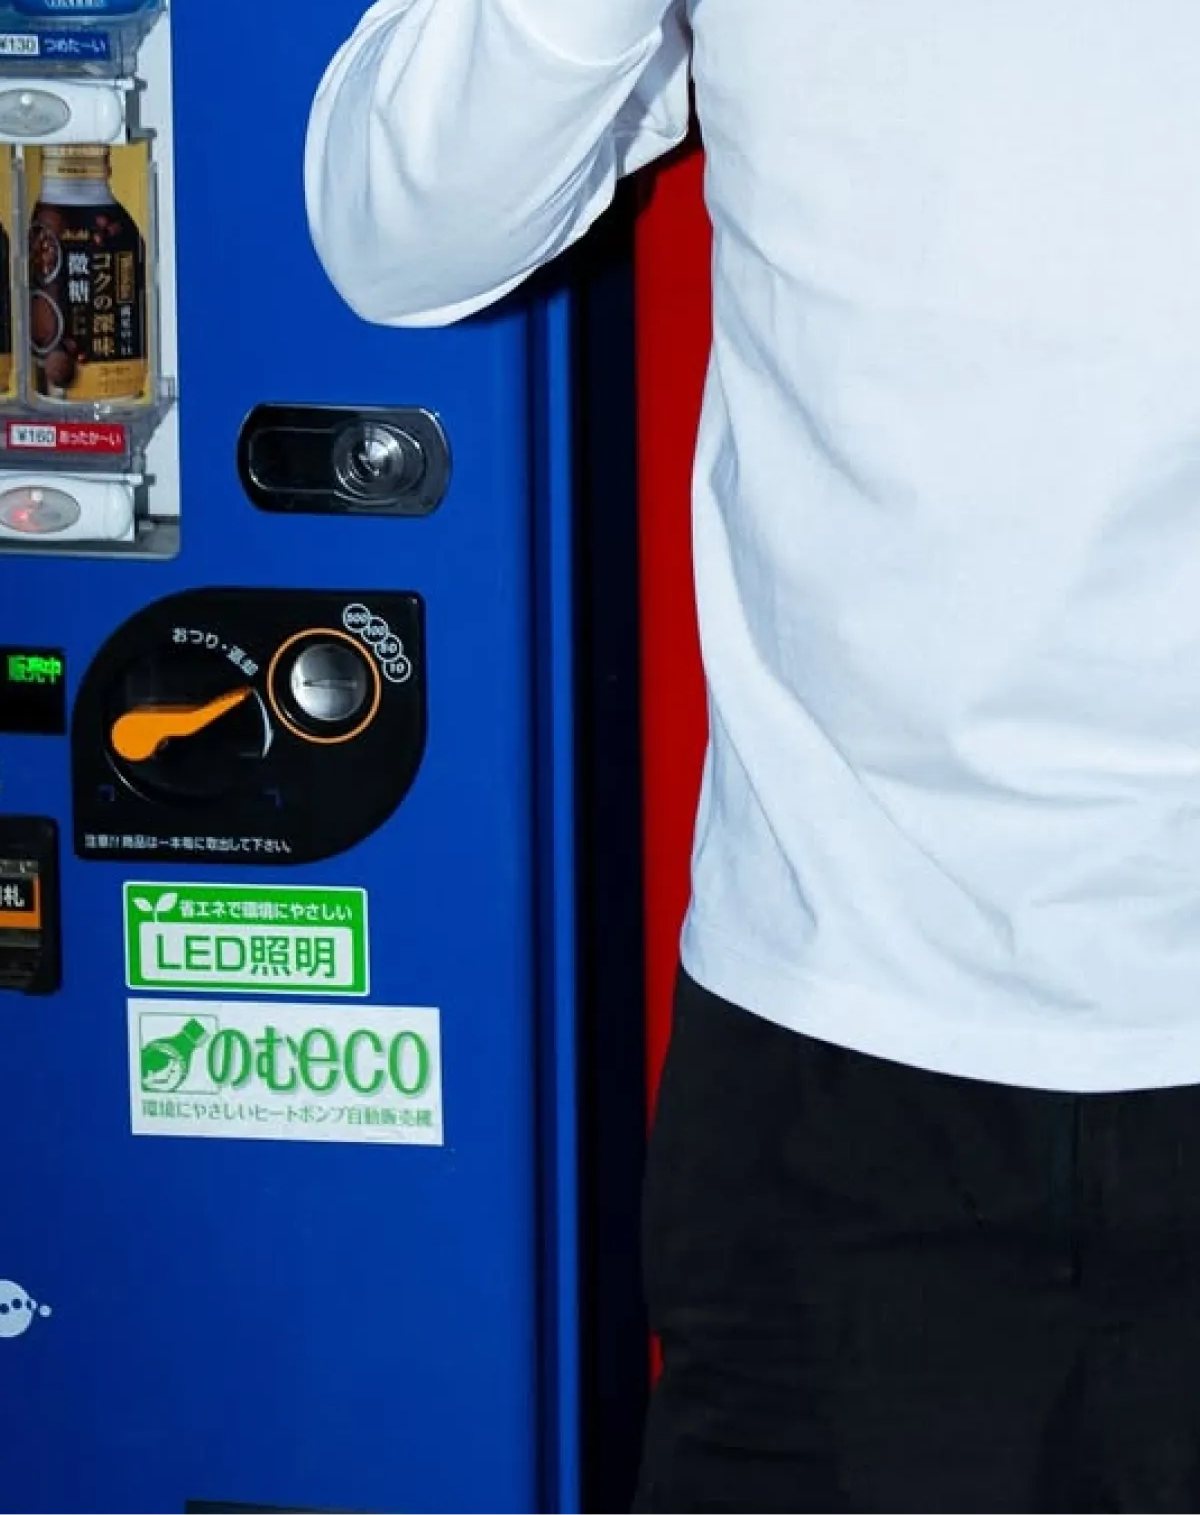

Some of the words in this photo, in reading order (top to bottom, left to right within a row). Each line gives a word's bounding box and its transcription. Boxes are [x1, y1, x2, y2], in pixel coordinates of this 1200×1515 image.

[180, 896, 353, 922] 省エネで環境にやさしい
[155, 933, 337, 978] LED照明
[207, 1026, 431, 1095] のむeco
[141, 1099, 434, 1128] 環境にやさしいヒートポンプ自動販売機
